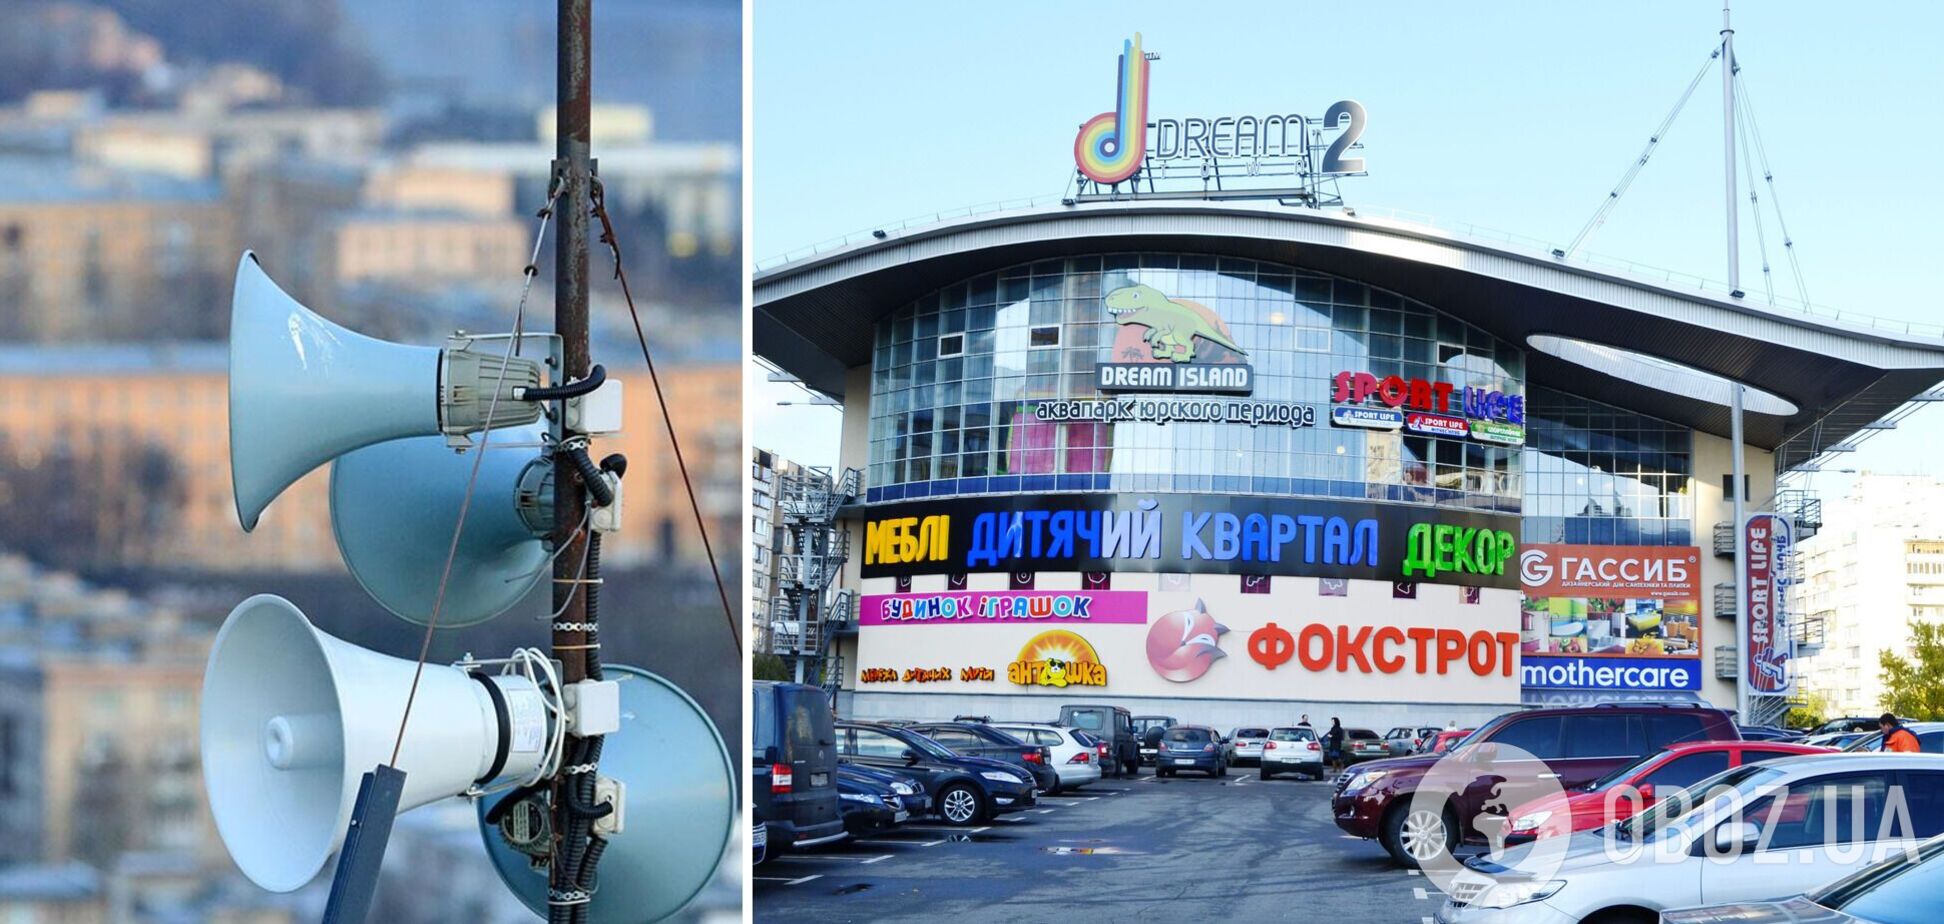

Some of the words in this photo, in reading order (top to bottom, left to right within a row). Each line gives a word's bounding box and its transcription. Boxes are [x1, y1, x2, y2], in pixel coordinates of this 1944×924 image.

[1155, 114, 1306, 159] DREAM
[1322, 99, 1367, 174] 2
[1101, 366, 1172, 386] DREAM
[1179, 367, 1248, 388] ISLAND
[1333, 371, 1454, 413] SPORT
[1036, 402, 1133, 422] аквапарк
[1138, 401, 1222, 423] юрского
[1225, 402, 1316, 428] периода
[1354, 410, 1379, 420] SPORT
[1424, 418, 1448, 428] SPORT
[865, 514, 950, 565] МЕБЛІ
[967, 499, 1162, 568] ДИТЯЧИЙ
[1181, 511, 1378, 566] КВАРТАЛ
[1402, 522, 1515, 578] ДЕКОР
[1561, 556, 1688, 582] ГАССИБ
[881, 597, 971, 620] БУДИНОК
[1751, 576, 1768, 643] SPORT
[1248, 622, 1519, 677] ФОКСТРОТ
[1521, 660, 1689, 688] mothercare
